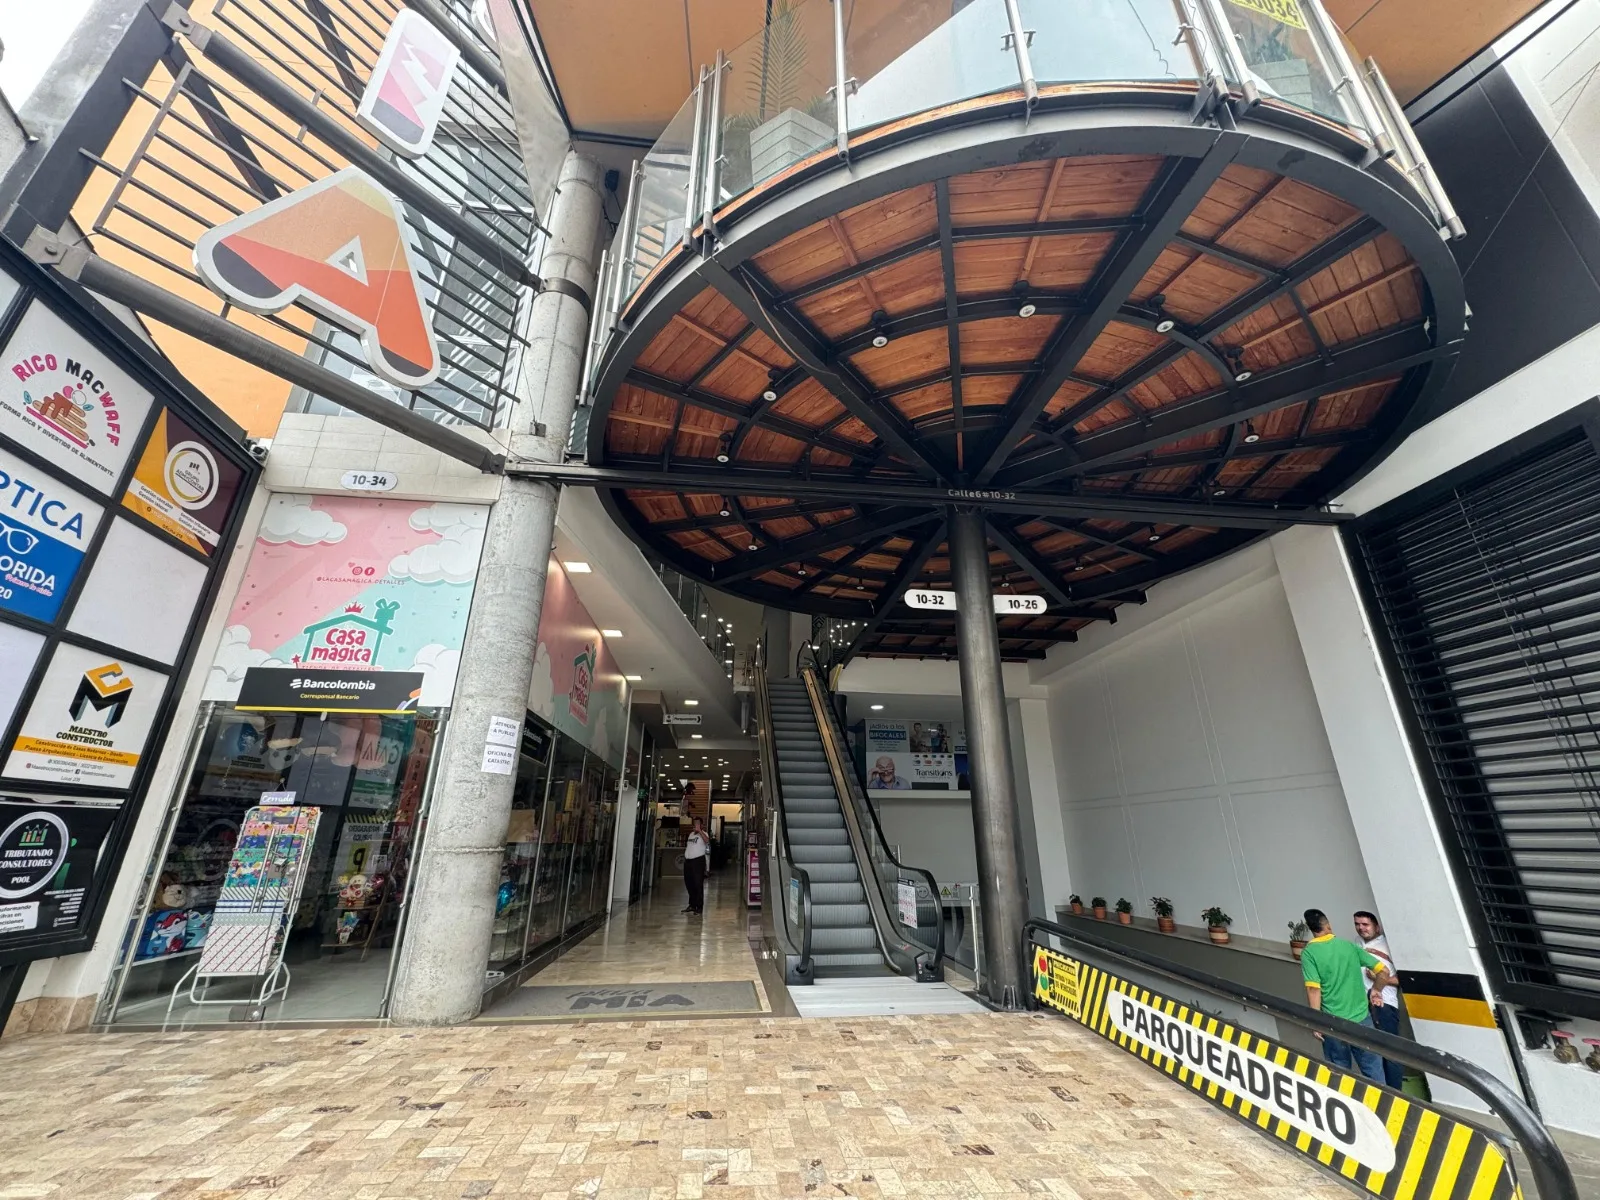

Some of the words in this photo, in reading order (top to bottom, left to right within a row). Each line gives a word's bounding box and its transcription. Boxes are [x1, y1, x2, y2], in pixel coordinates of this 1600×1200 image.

[192, 165, 441, 391] A
[12, 353, 58, 382] RICO
[21, 415, 36, 428] RICA
[42, 427, 71, 450] DIVERTIDA
[71, 446, 79, 456] DE
[351, 474, 387, 487] 10-34
[0, 555, 55, 590] ORIDA
[915, 593, 945, 606] 10-32
[1008, 599, 1038, 610] 10-26
[311, 645, 371, 662] mágica
[303, 678, 376, 690] Bancolombia
[68, 724, 108, 738] MAESTRO
[869, 731, 906, 739] BIFOCALES!
[56, 731, 114, 748] CONSTRUCTOR
[261, 794, 294, 803] Cerrado
[4, 848, 54, 858] TRIBUTANDO
[0, 858, 53, 869] CONSULTORES
[11, 875, 31, 884] POOL
[1122, 999, 1356, 1145] PARQUEADERO
